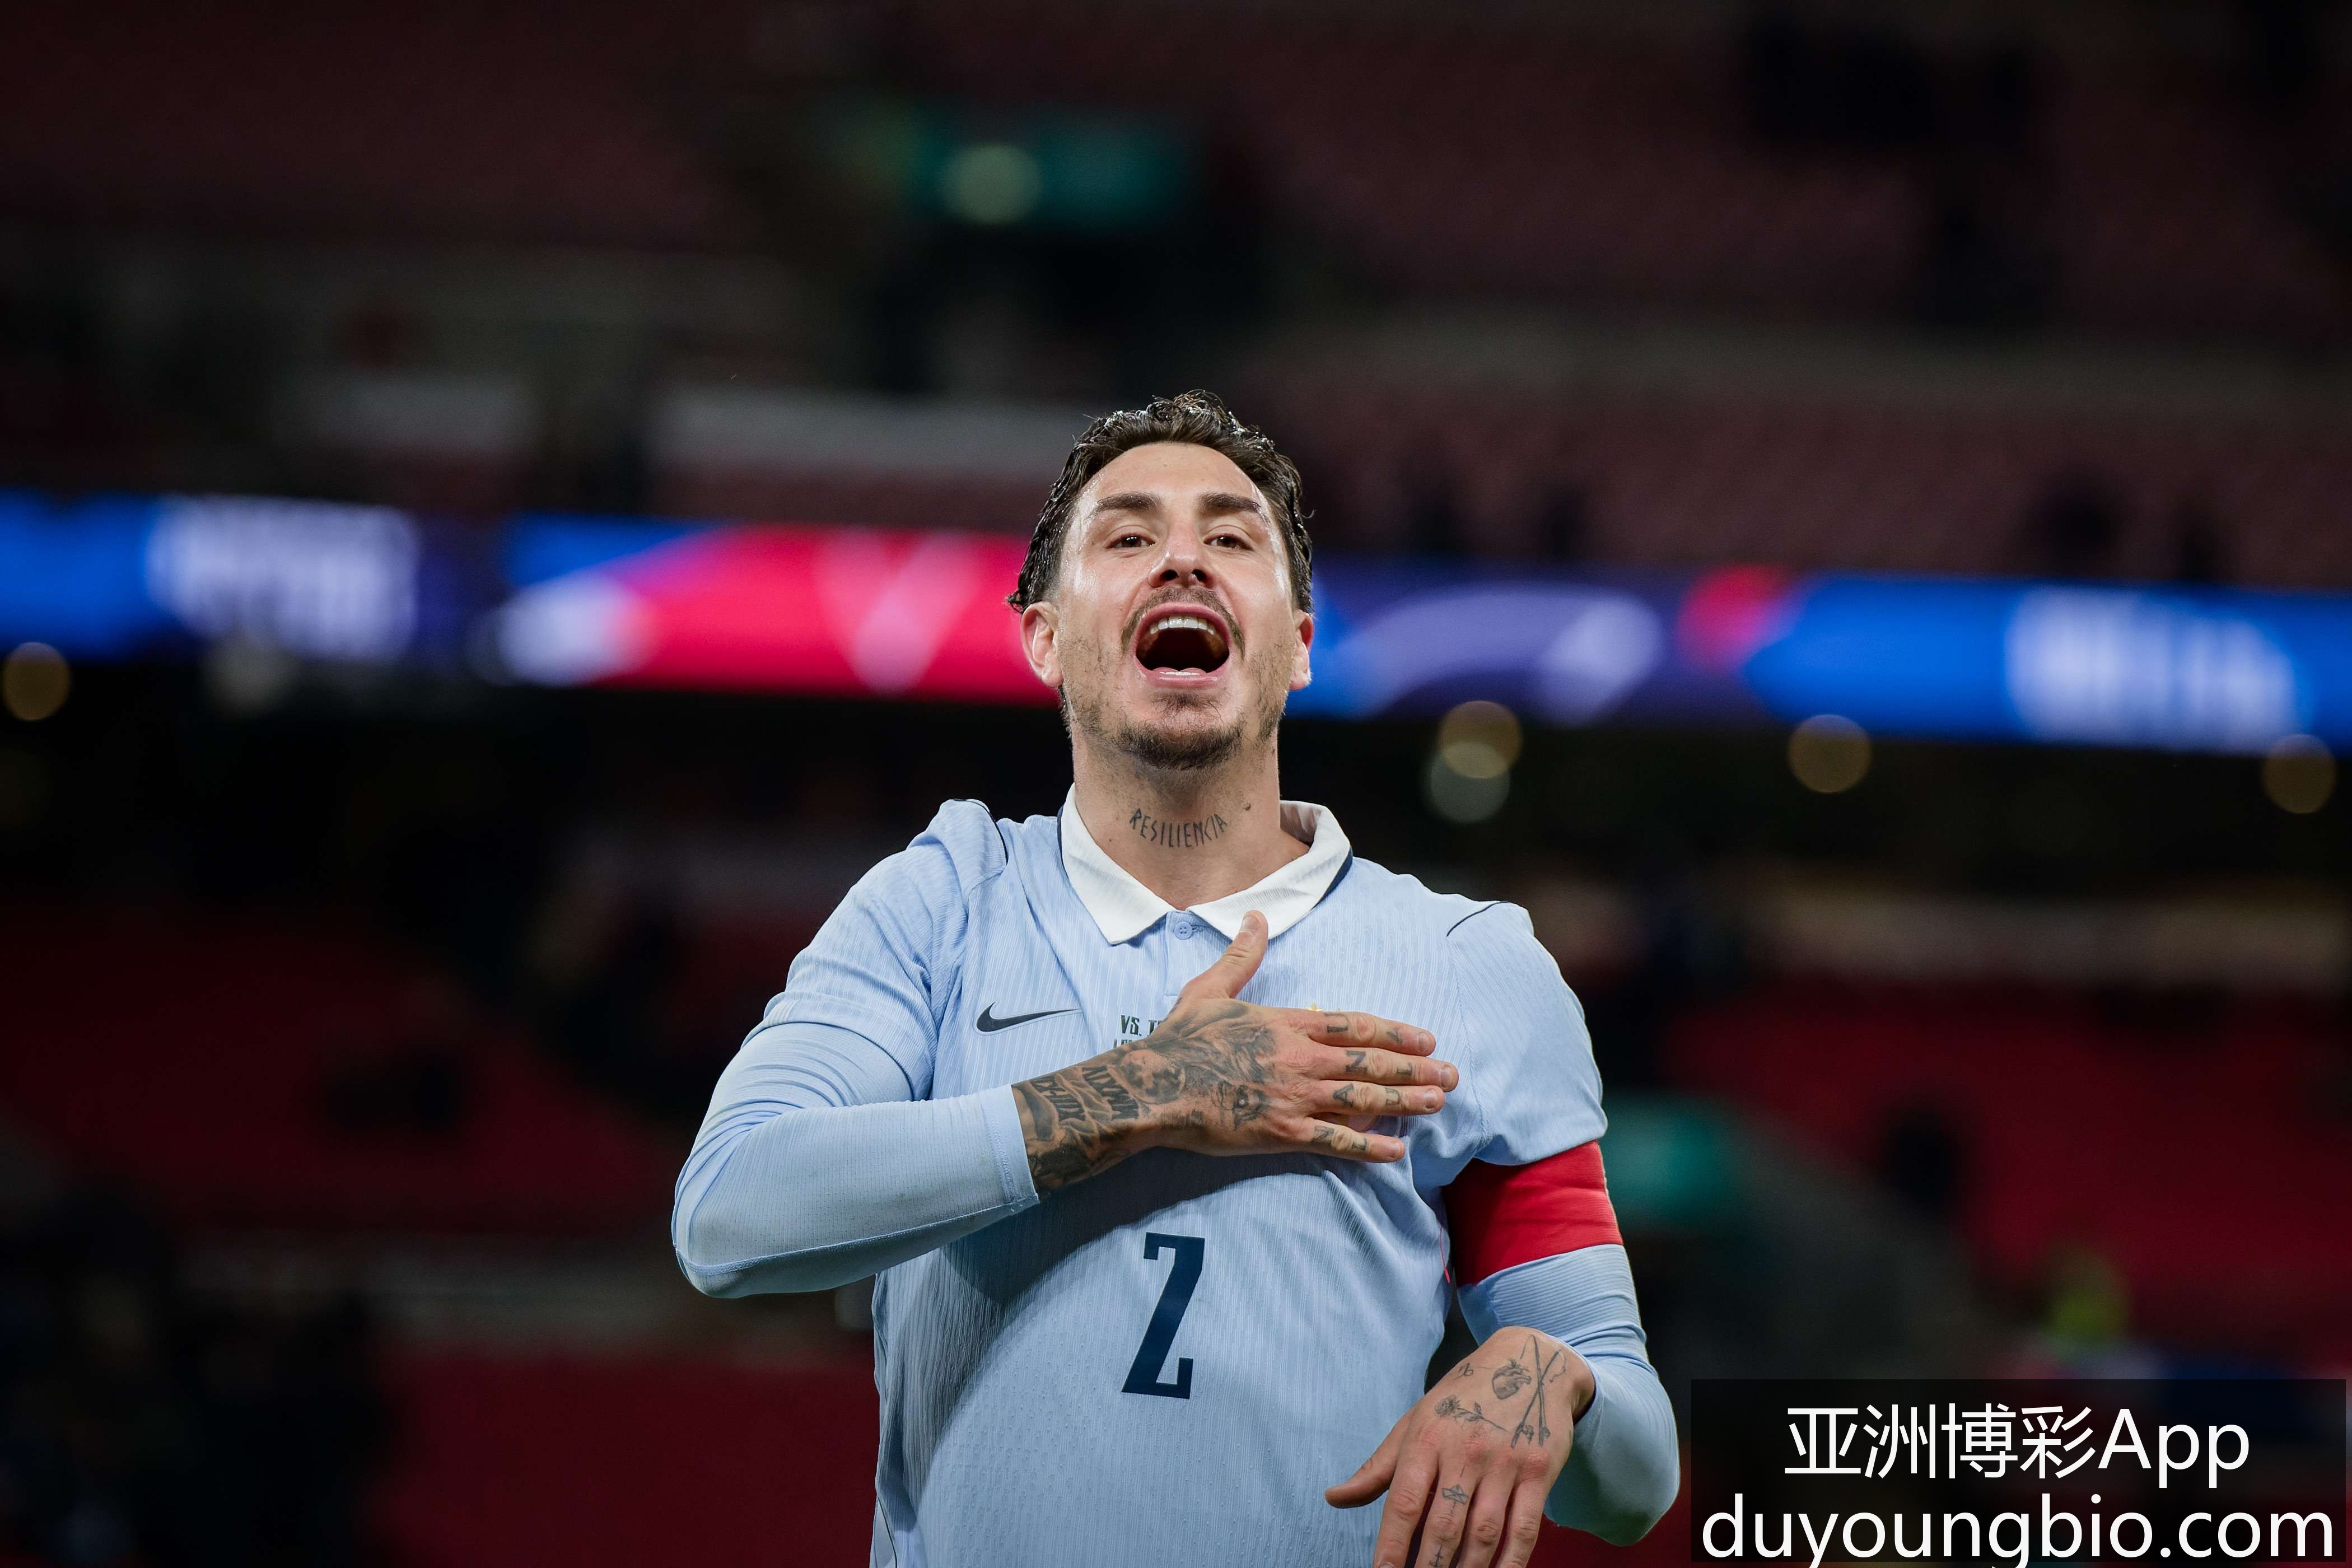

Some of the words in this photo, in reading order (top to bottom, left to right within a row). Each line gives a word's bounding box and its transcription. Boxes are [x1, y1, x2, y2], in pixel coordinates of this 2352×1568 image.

[1130, 808, 1228, 847] RESILIENCIA
[1121, 1015, 1142, 1036] VS.
[1148, 1020, 1163, 1035] T
[1121, 1231, 1205, 1399] 2
